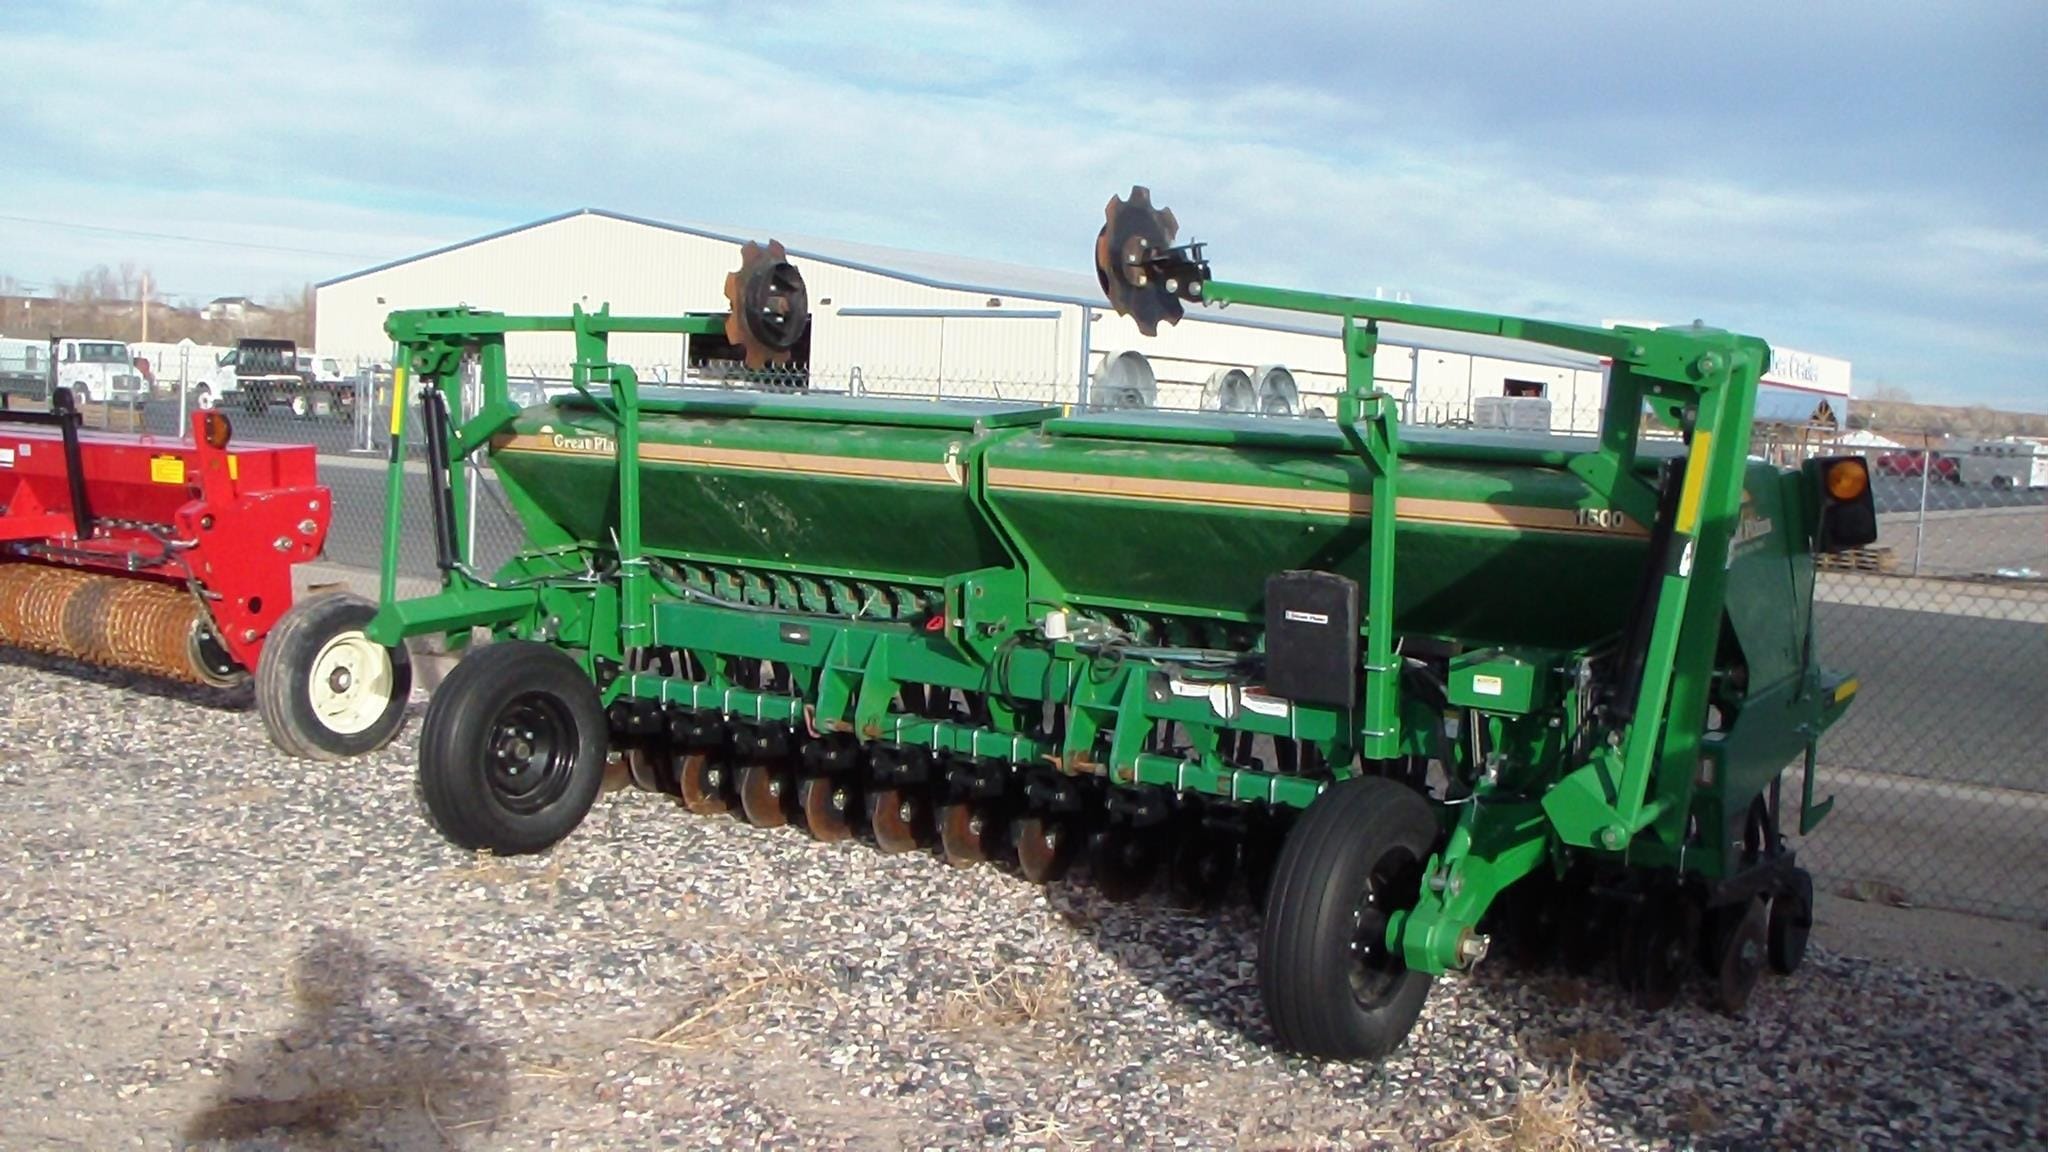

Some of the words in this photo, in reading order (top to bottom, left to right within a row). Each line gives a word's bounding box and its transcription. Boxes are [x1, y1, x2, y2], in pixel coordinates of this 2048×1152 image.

[553, 433, 591, 450] Great
[594, 436, 618, 451] Pla
[1578, 508, 1624, 528] 1500
